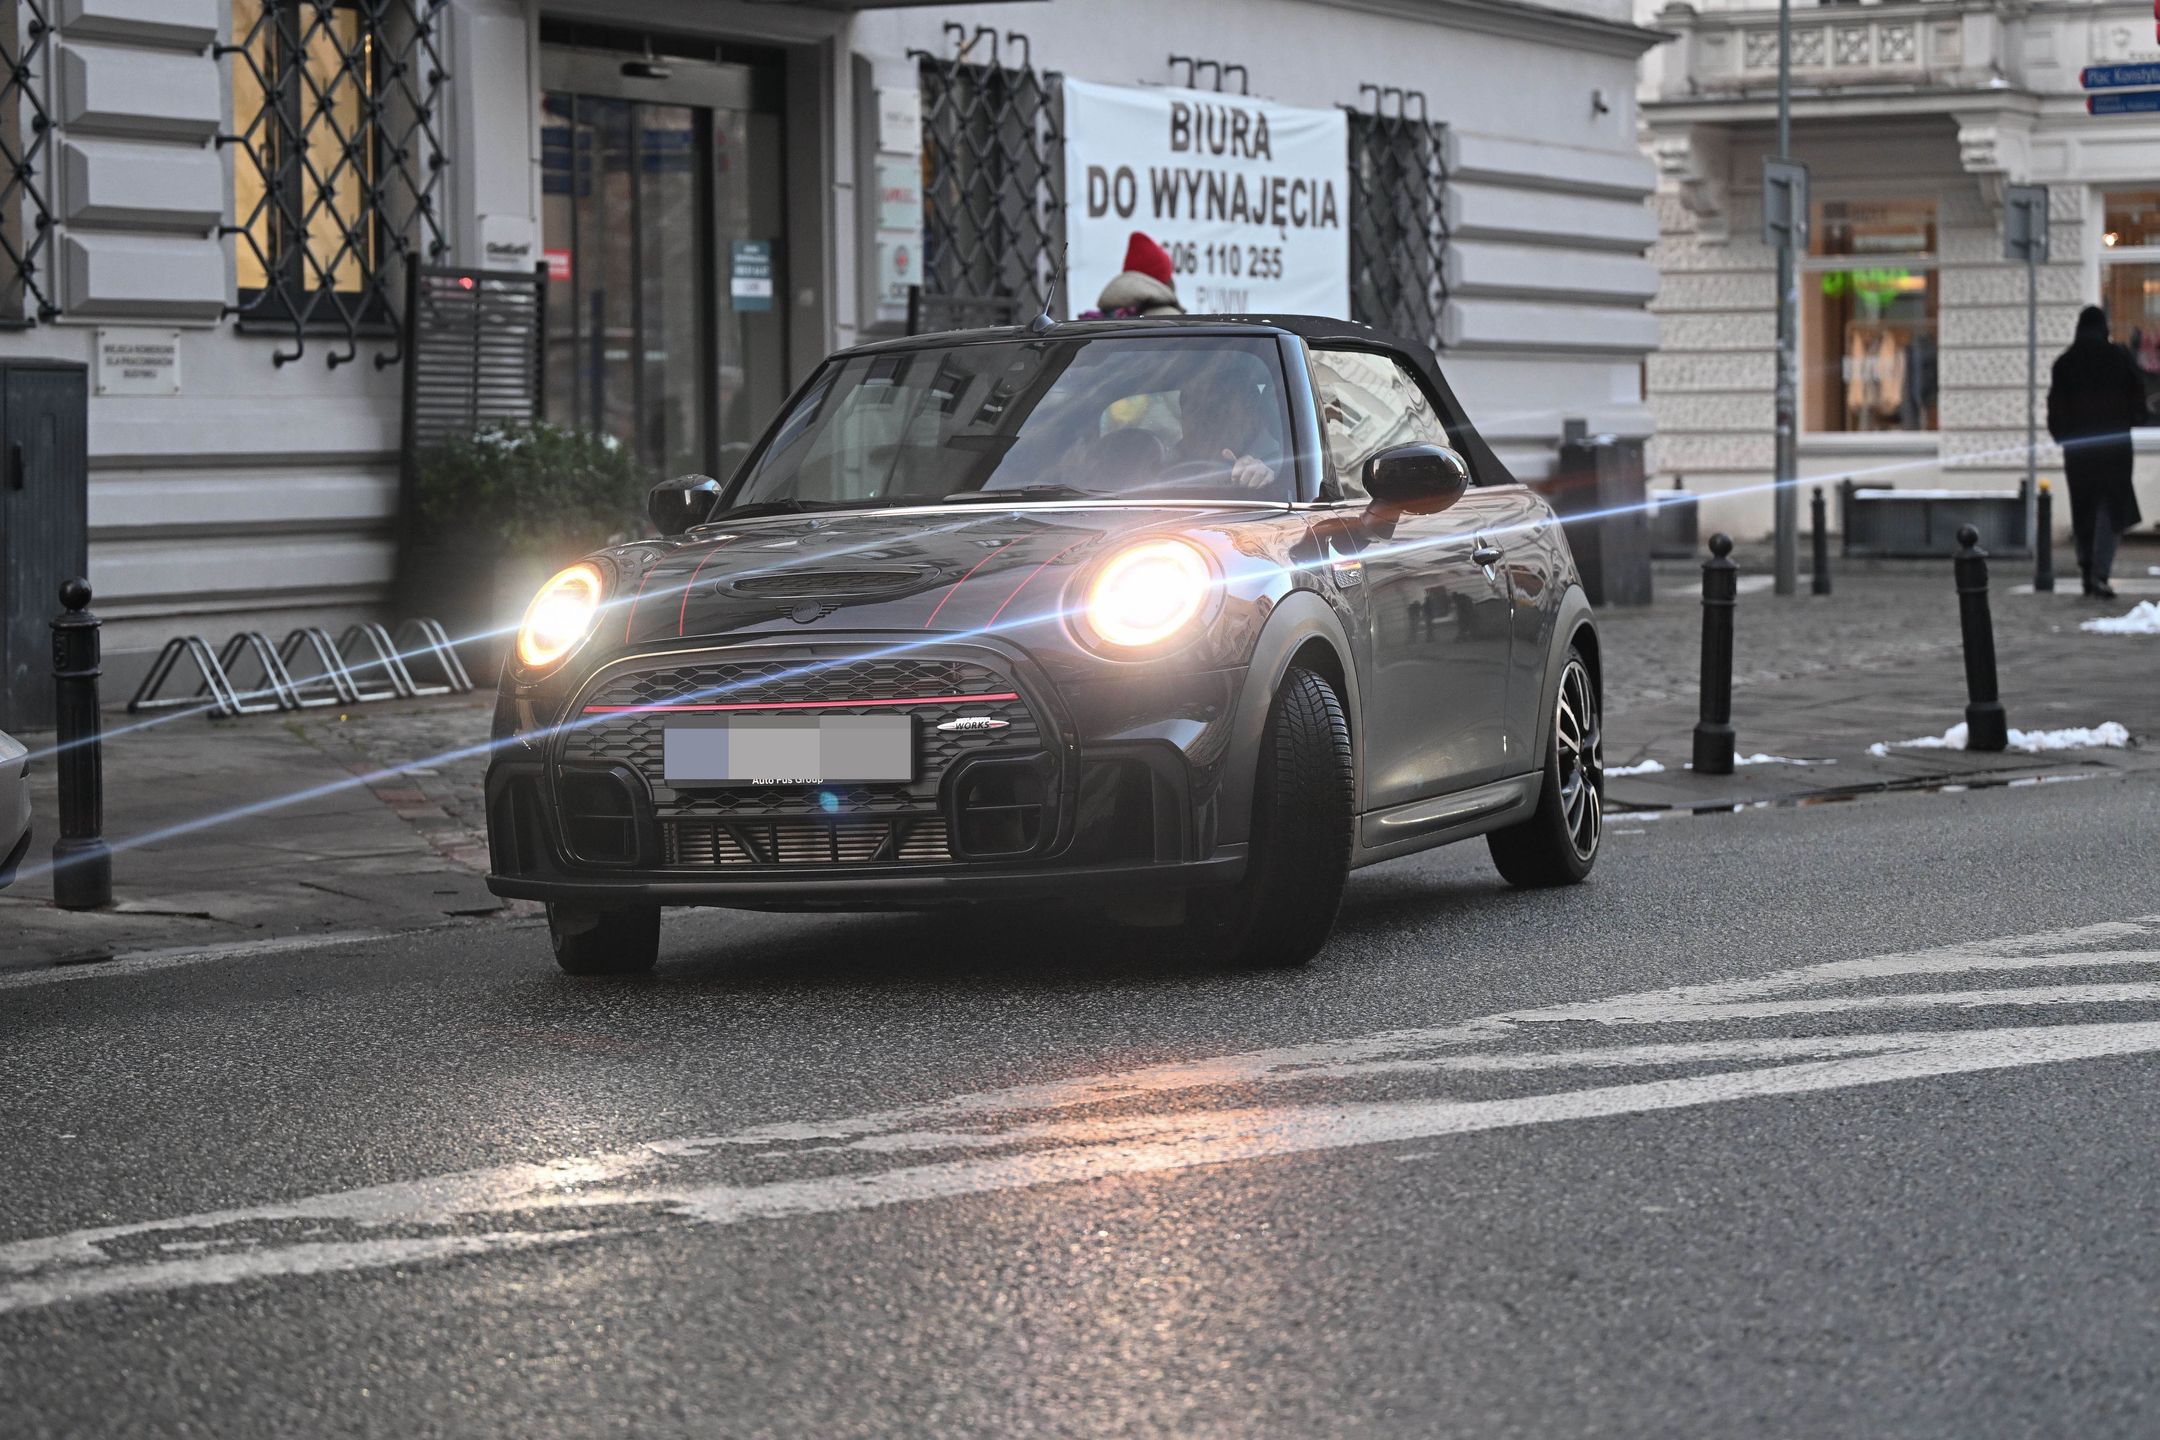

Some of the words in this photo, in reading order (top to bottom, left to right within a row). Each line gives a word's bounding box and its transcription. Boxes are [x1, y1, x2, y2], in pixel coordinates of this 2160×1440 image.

[1170, 101, 1272, 161] BIURA
[1088, 166, 1137, 218] DO
[1150, 167, 1339, 241] WYNAJĘCIA
[1204, 243, 1242, 277] 110
[1247, 245, 1283, 279] 255
[955, 720, 990, 730] WORKS
